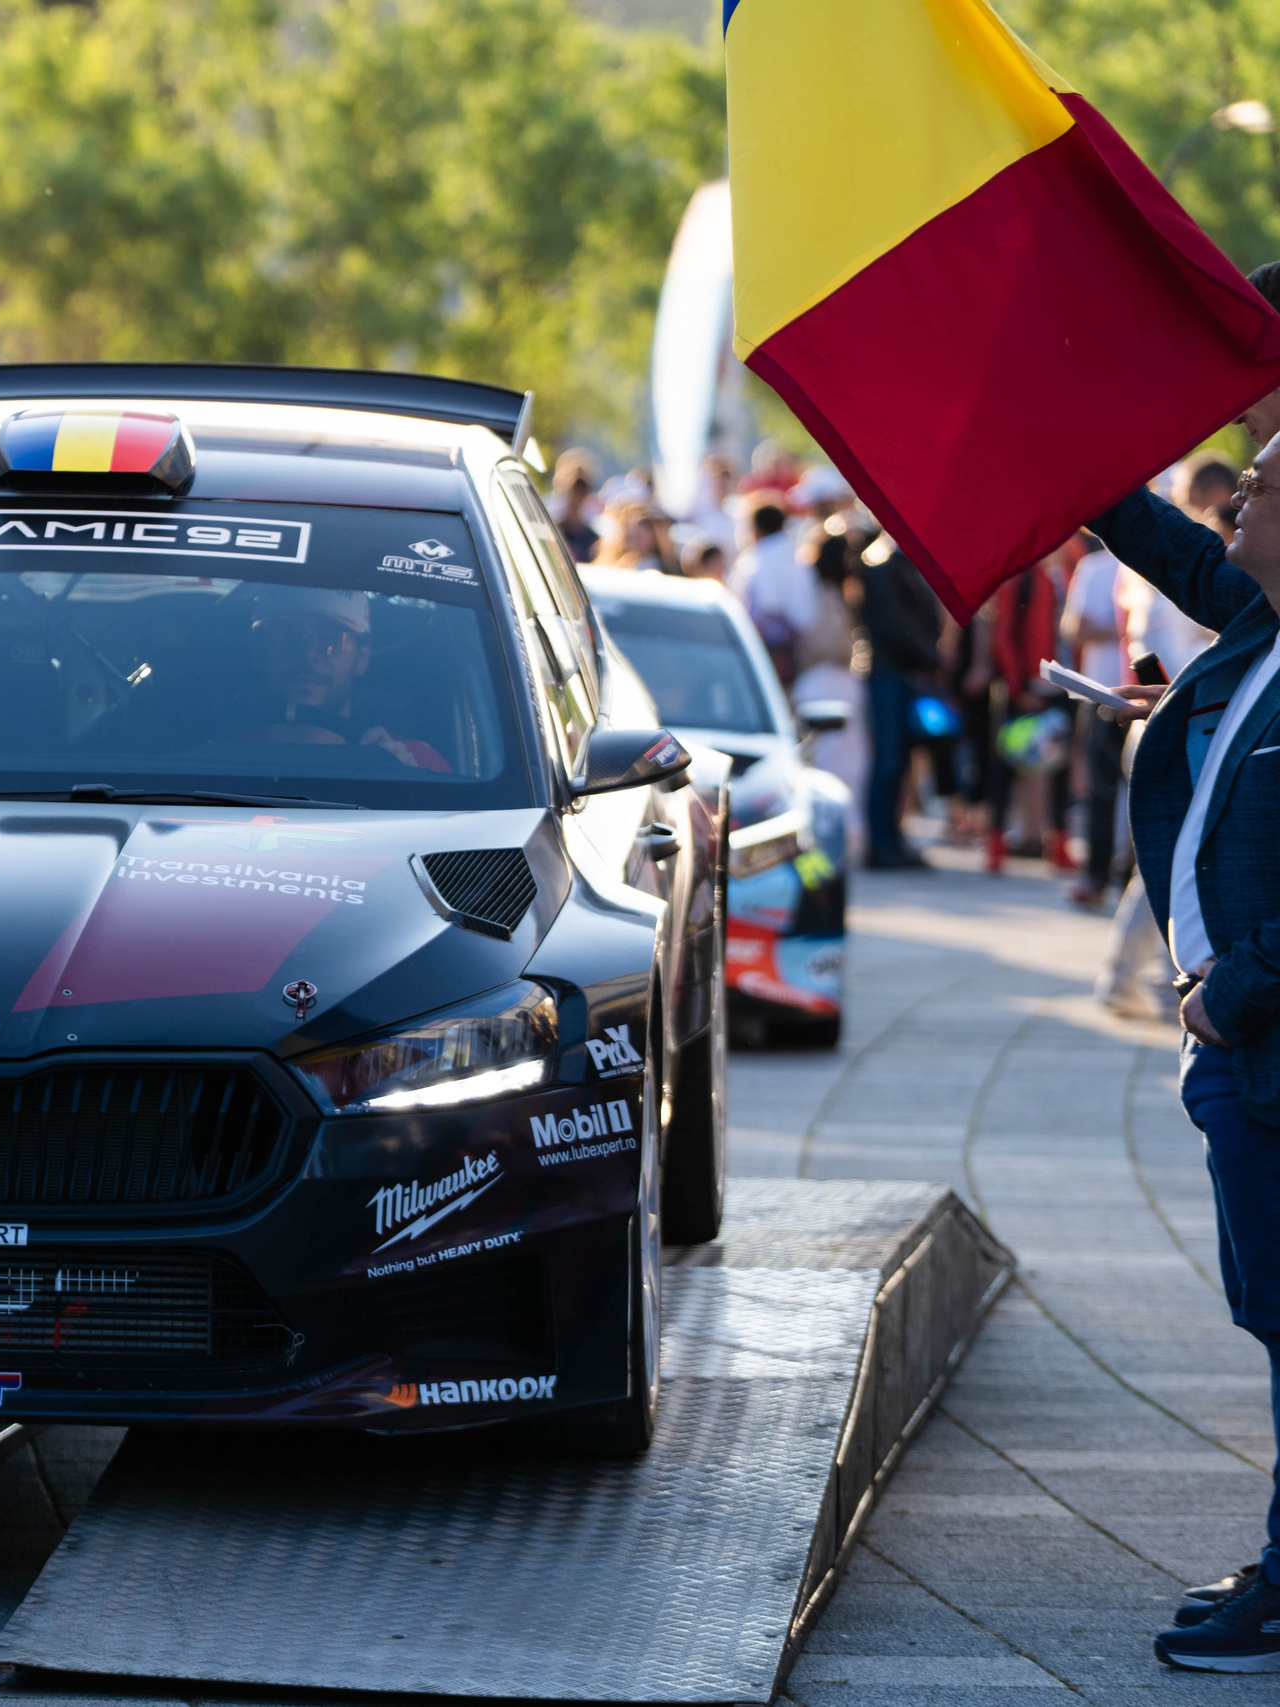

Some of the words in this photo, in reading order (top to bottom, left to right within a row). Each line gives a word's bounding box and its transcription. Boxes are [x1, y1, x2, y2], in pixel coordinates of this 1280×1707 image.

[117, 866, 365, 905] Investments
[120, 853, 367, 892] Transilvania
[529, 1103, 608, 1148] Mobil
[538, 1137, 637, 1167] www.lubexpert.ro
[367, 1259, 414, 1278] Nothing
[417, 1252, 437, 1267] but
[438, 1241, 482, 1261] HEAVY
